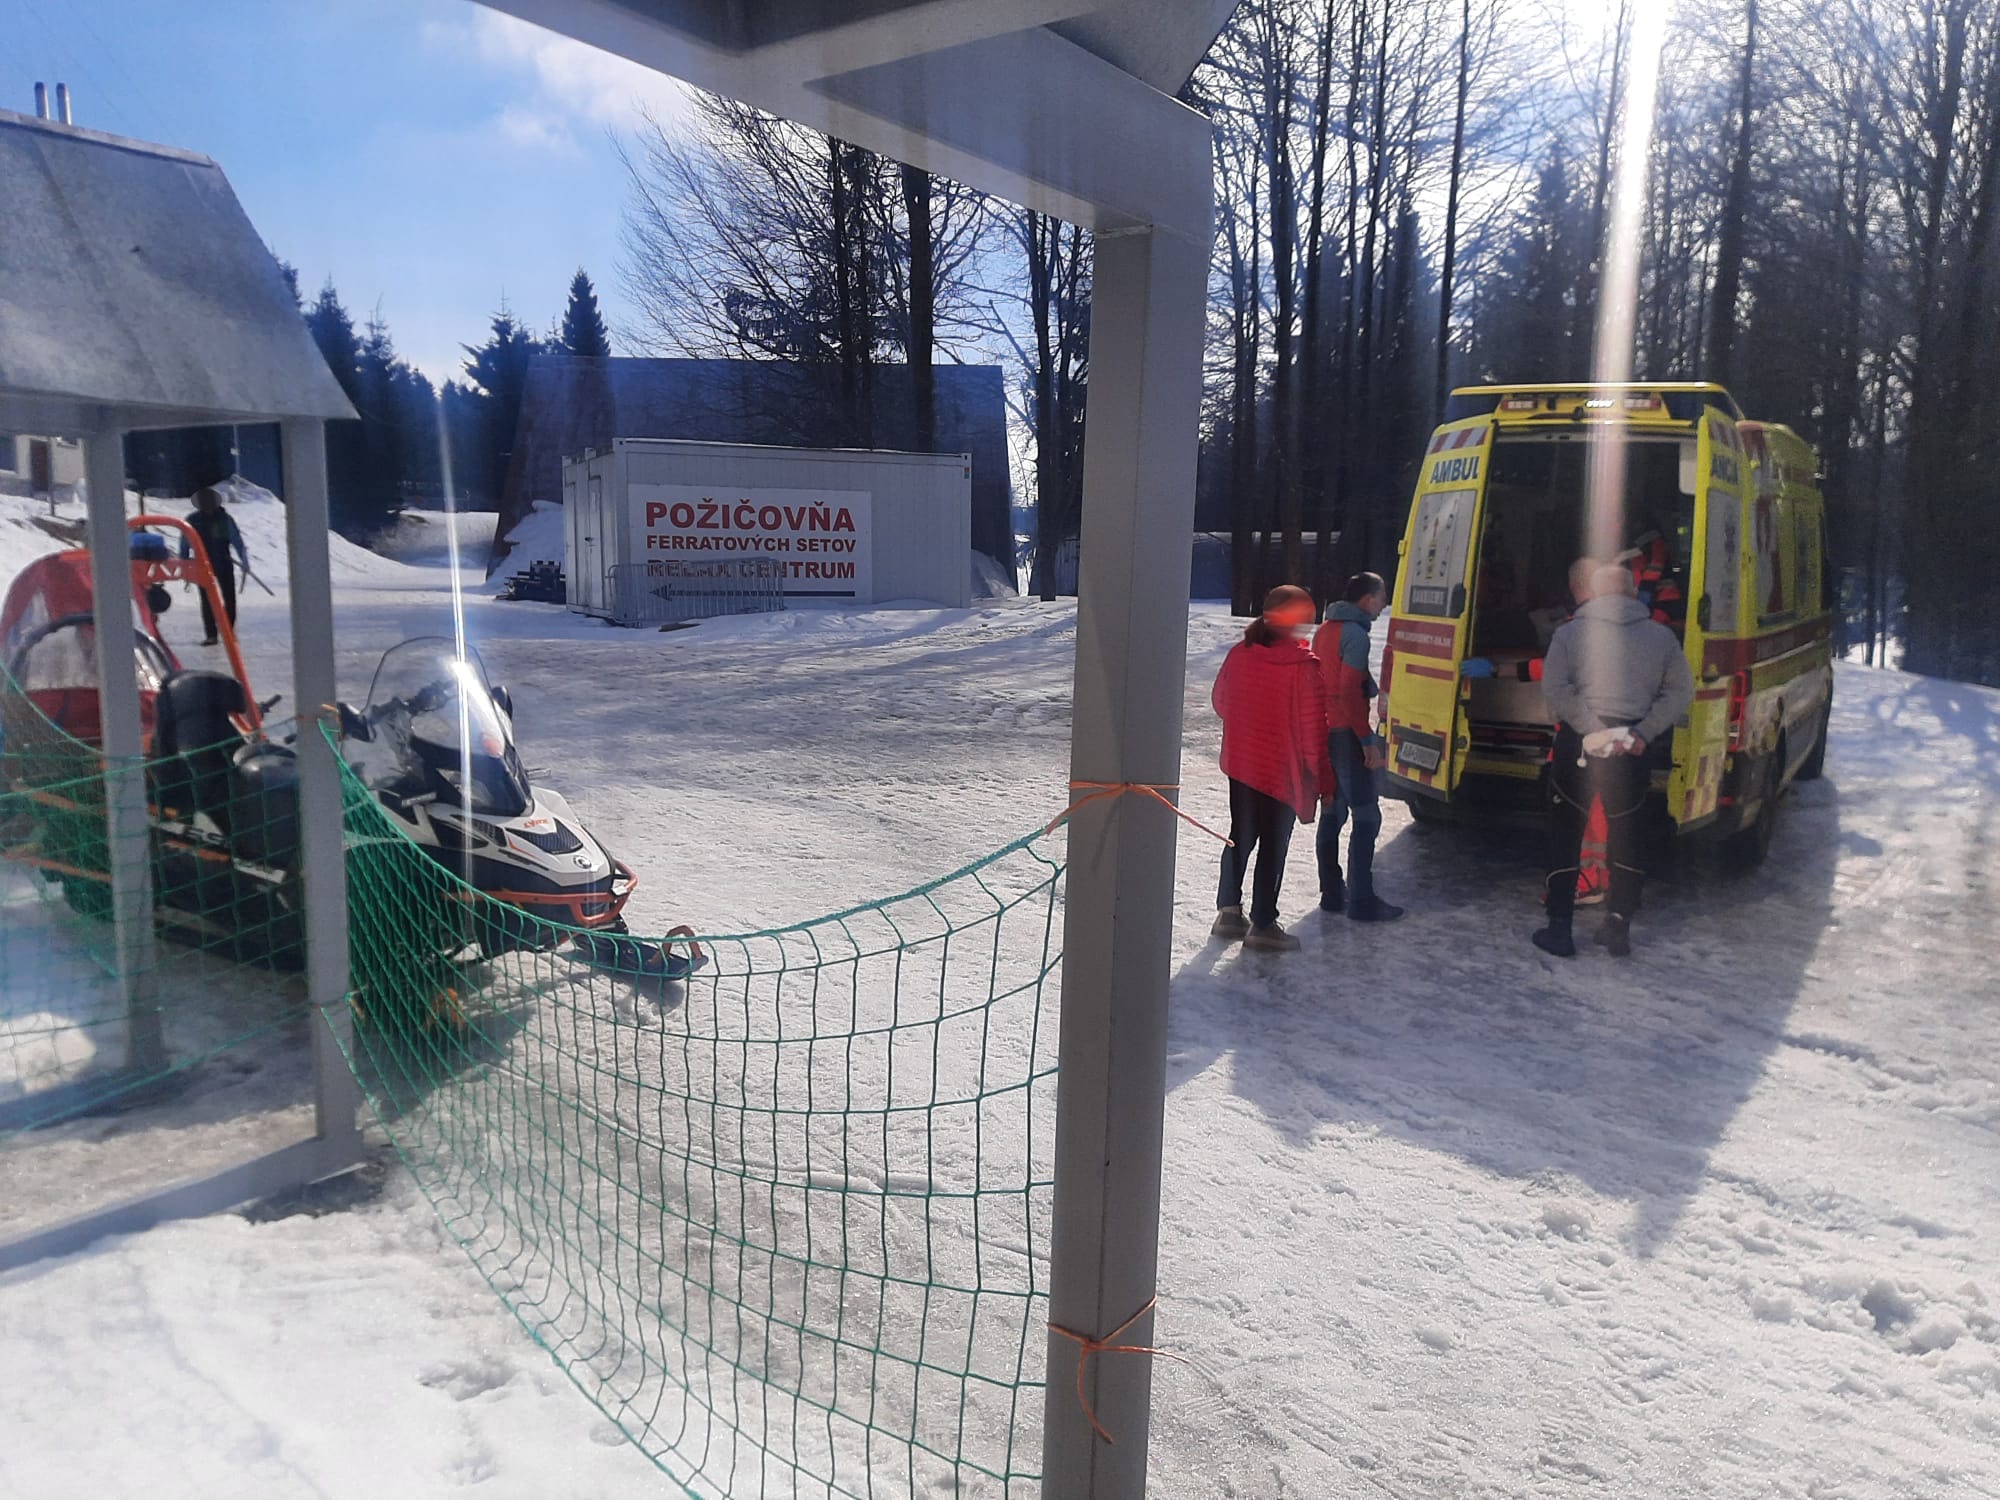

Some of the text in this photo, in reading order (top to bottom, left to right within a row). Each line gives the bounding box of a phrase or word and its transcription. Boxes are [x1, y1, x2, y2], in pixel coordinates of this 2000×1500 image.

[1430, 456, 1480, 484] AMBUL
[646, 498, 856, 532] POŽIČOVŇA
[647, 534, 857, 552] FERRATOVÝCH SETOV
